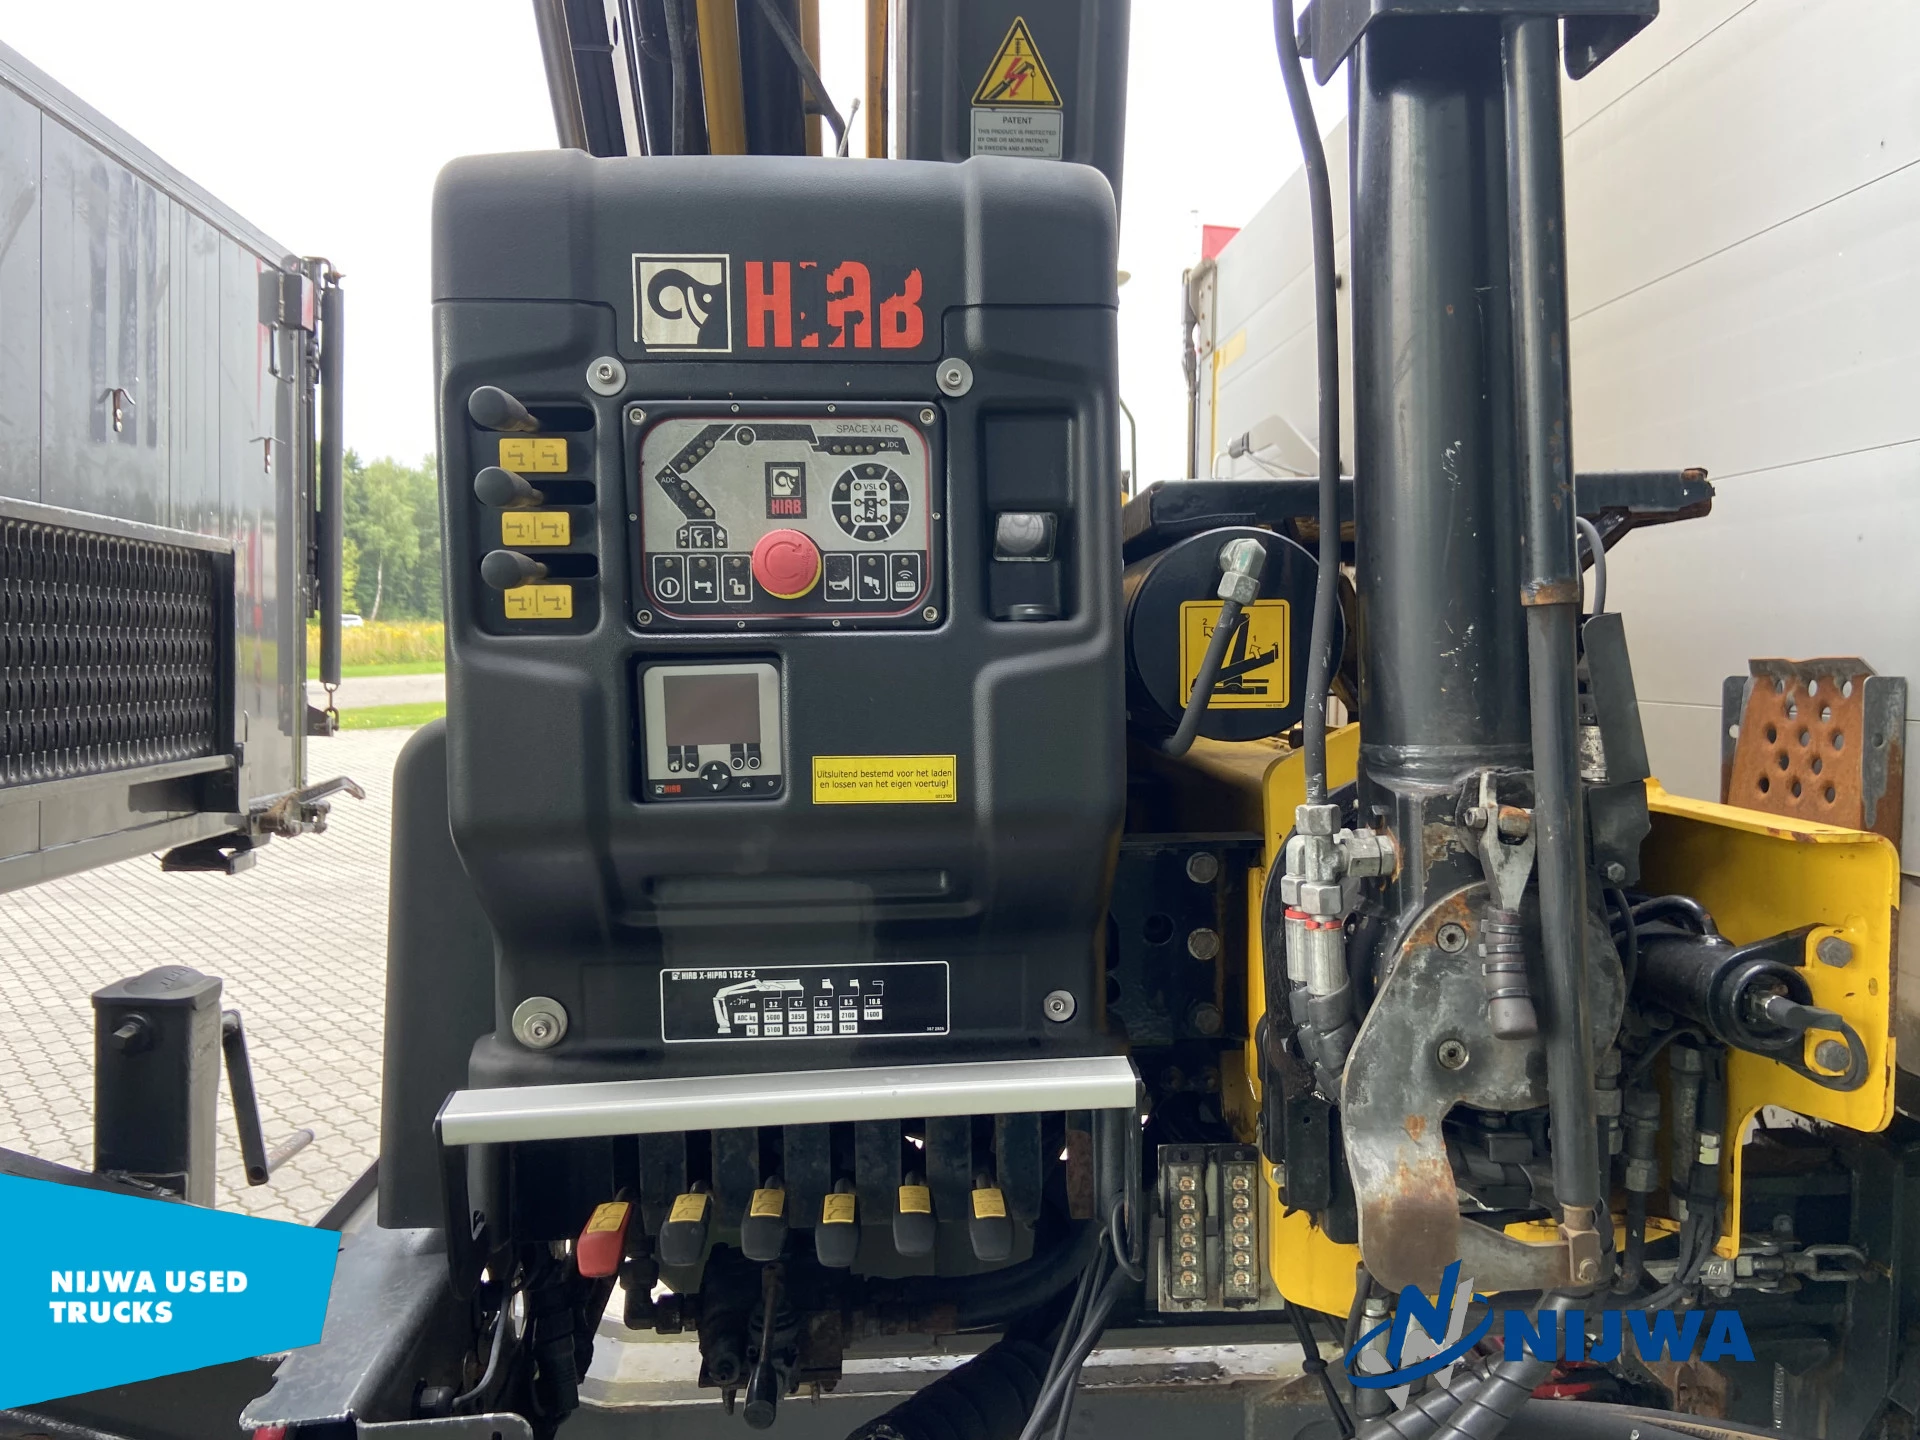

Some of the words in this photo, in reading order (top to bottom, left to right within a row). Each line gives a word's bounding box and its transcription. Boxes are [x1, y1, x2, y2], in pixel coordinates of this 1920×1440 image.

[745, 261, 924, 348] HAB
[836, 425, 868, 433] SPACE
[772, 500, 801, 514] HIAB
[680, 530, 688, 540] P
[891, 780, 912, 789] eigen
[914, 780, 949, 789] voertuig!
